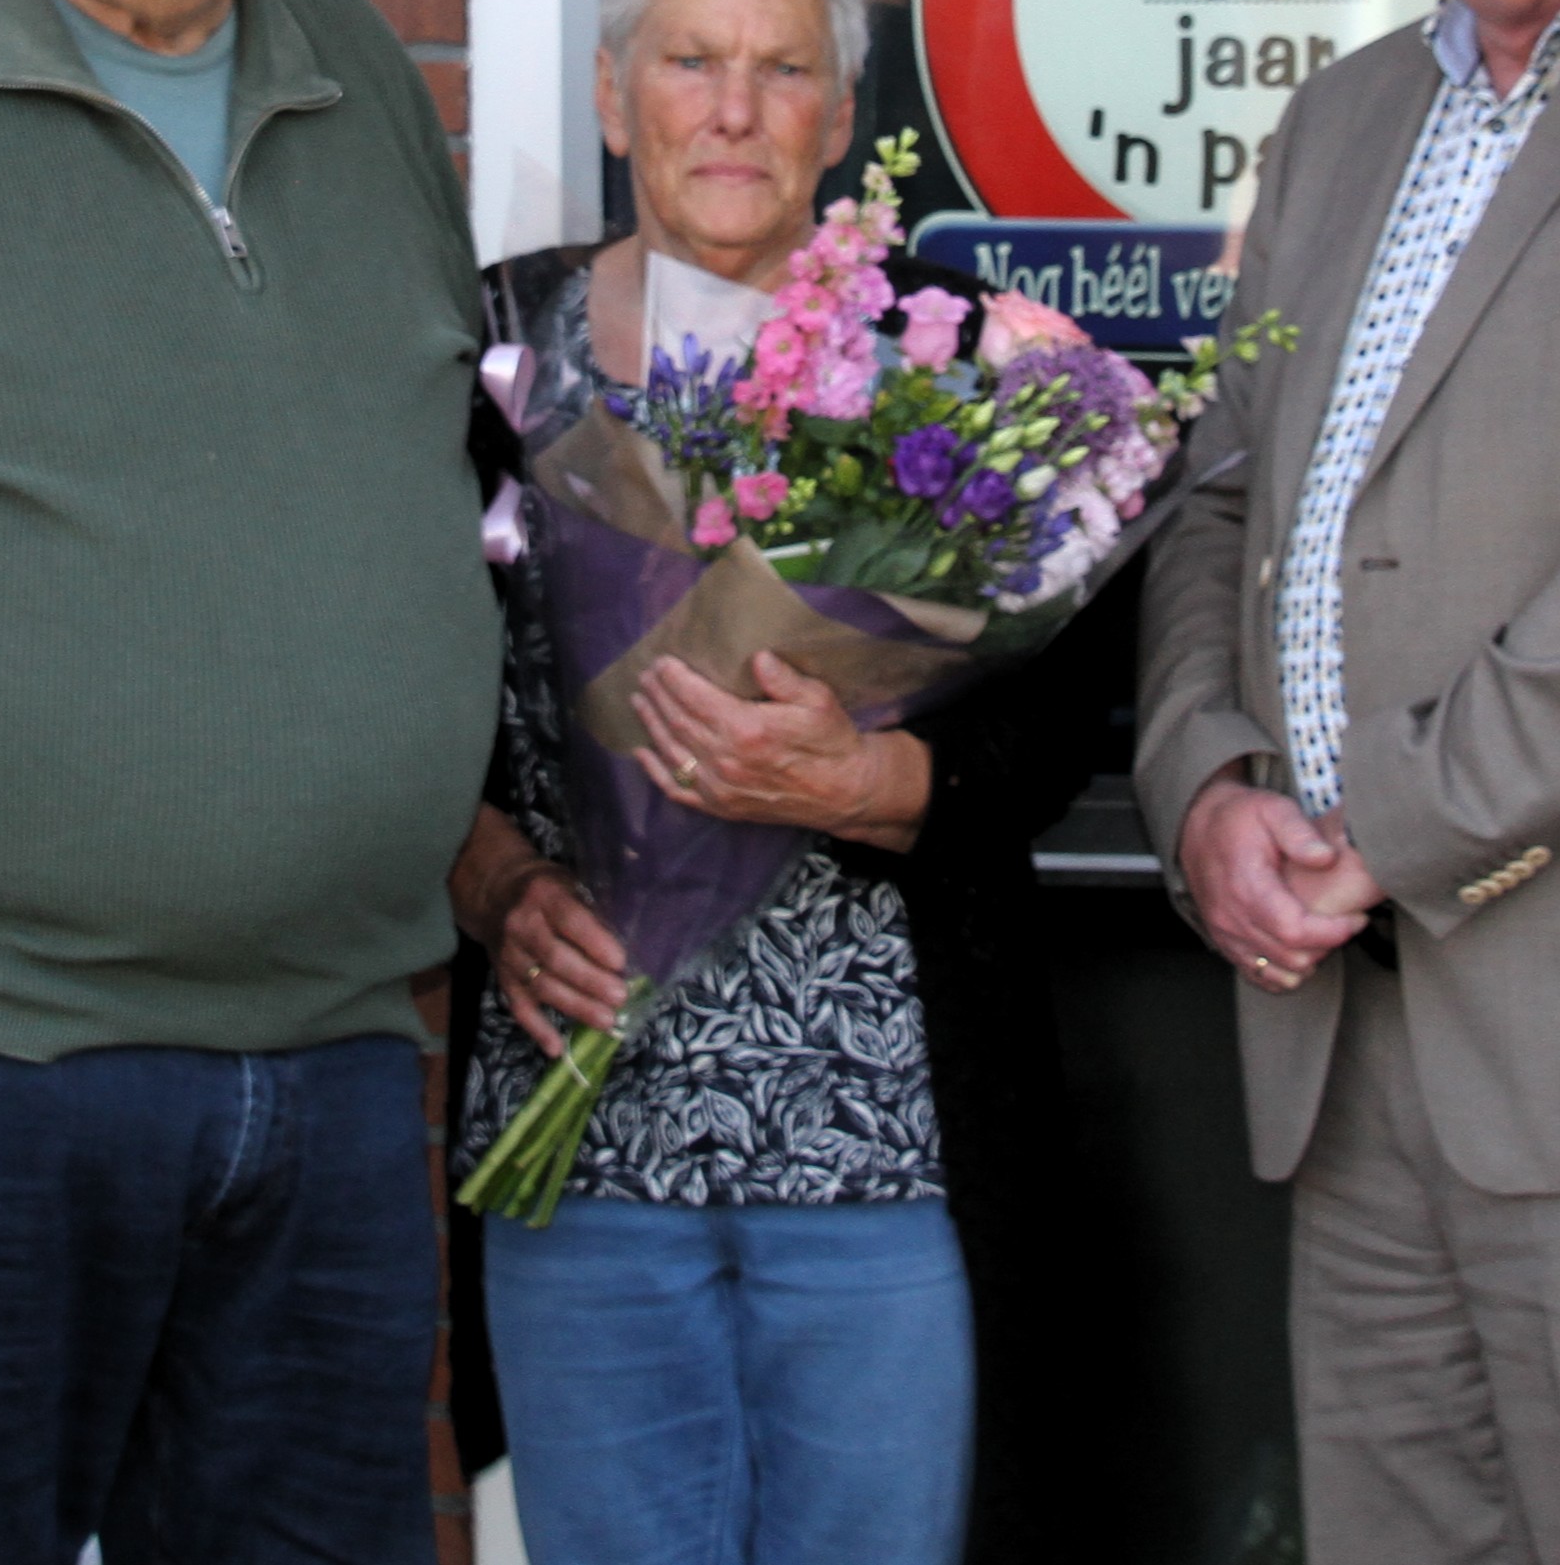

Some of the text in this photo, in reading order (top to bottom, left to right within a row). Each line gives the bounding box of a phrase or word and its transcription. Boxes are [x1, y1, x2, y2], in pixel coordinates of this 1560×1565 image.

[1161, 14, 1335, 115] jaar
[1090, 109, 1159, 184] 'n
[1069, 242, 1162, 318] héél
